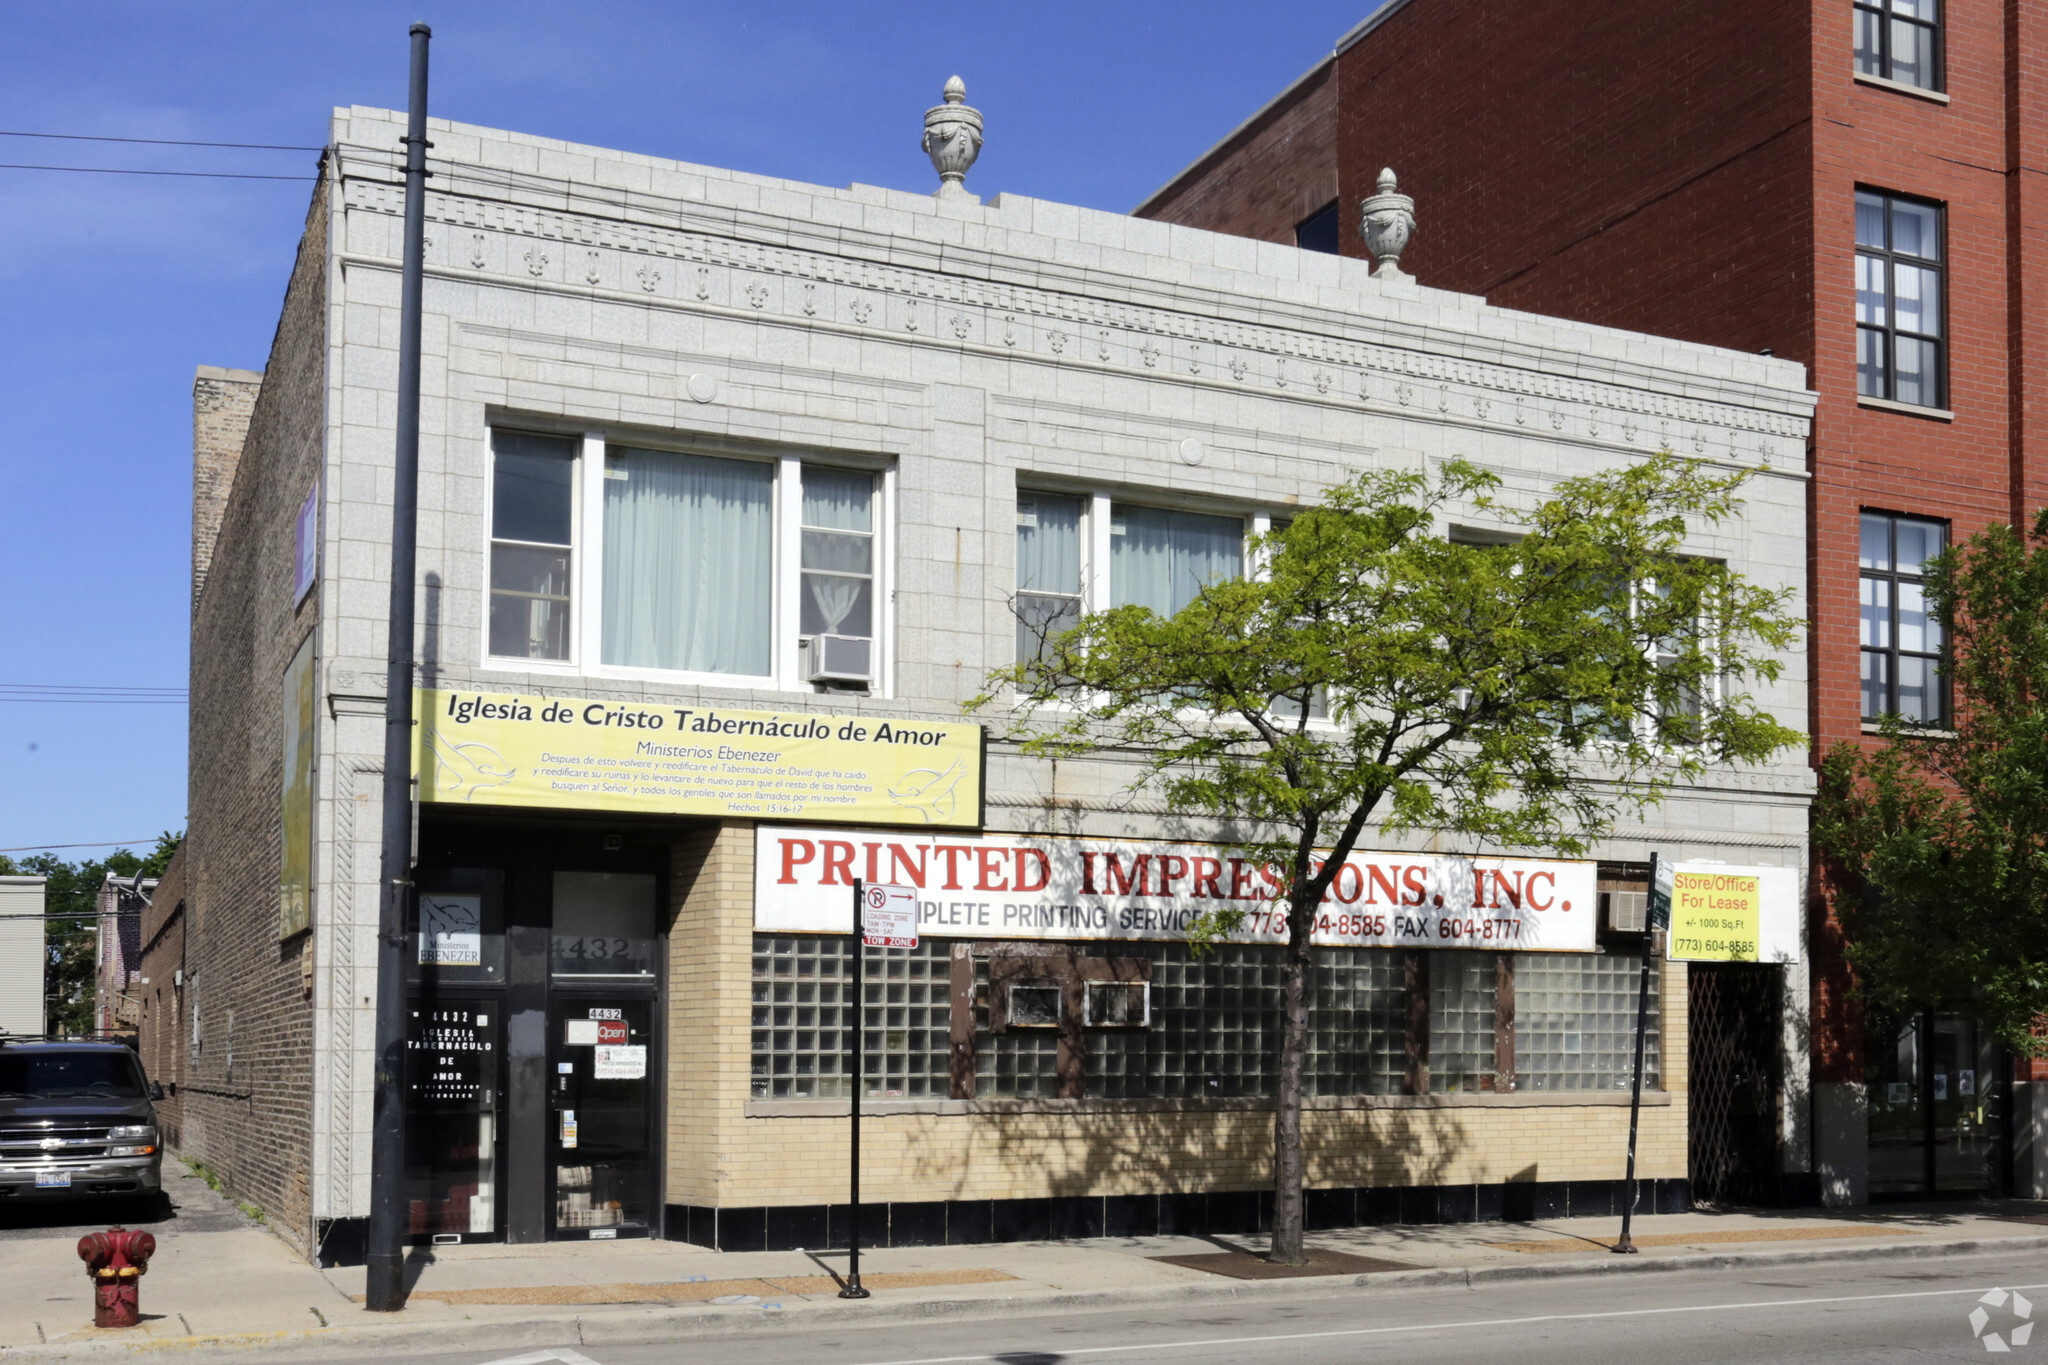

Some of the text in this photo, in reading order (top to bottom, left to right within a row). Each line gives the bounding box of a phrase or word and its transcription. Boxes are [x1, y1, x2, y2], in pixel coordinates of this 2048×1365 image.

[448, 694, 946, 746] Iglesia de Cristo Tabernáculo de Amor
[636, 741, 781, 762] Ministerios Ebenezer
[541, 753, 580, 765] Despues
[584, 755, 595, 765] de
[598, 756, 616, 766] esto
[655, 761, 659, 770] y
[711, 763, 718, 772] el
[721, 764, 773, 775] Tabernáculo
[776, 766, 786, 775] de
[789, 766, 813, 777] David
[815, 770, 830, 780] que
[833, 769, 841, 778] ha
[533, 768, 538, 776] y
[604, 771, 630, 780] ruinas
[633, 773, 638, 781] y
[641, 772, 649, 781] lo
[695, 774, 705, 784] de
[708, 778, 733, 786] nuevo
[736, 780, 754, 788] para
[757, 780, 773, 789] que
[776, 779, 783, 788] el
[785, 781, 807, 789] resto
[810, 780, 820, 790] de
[823, 780, 834, 790] los
[837, 781, 872, 792] hombres
[552, 780, 589, 792] busquen
[592, 781, 599, 791] al
[633, 786, 638, 794] y
[641, 785, 666, 795] todos
[669, 786, 681, 796] los
[683, 787, 716, 798] gentiles
[718, 791, 734, 800] que
[737, 791, 752, 799] son
[754, 790, 790, 801] llamados
[793, 794, 808, 803] por
[811, 793, 821, 802] mi
[824, 793, 856, 804] nombre
[727, 802, 802, 814] Hechos 15:16-17
[777, 838, 1572, 912] PRINTED IMPRESONS, INC.
[1674, 874, 1755, 892] Store/Office
[1681, 893, 1748, 910] For Lease
[866, 913, 891, 921] LOADING
[917, 901, 990, 926] PLETE
[1003, 904, 1107, 929] PRINTING
[1394, 916, 1429, 937] FAX
[1439, 918, 1520, 939] 604-8777
[1686, 917, 1744, 931] +/- 1000 Sq.Ft
[430, 940, 469, 950] Ministerios
[866, 936, 913, 947] TOW ZONE
[1675, 938, 1755, 953] (773) 604-8585
[420, 949, 479, 962] EBENEZER
[433, 1011, 468, 1022] 4432
[590, 1009, 620, 1019] 4432
[422, 1028, 474, 1038] IGLESIA
[598, 1026, 626, 1040] Open
[407, 1040, 492, 1051] TABERNACULO
[440, 1057, 454, 1066] DE
[432, 1072, 462, 1081] AMOR
